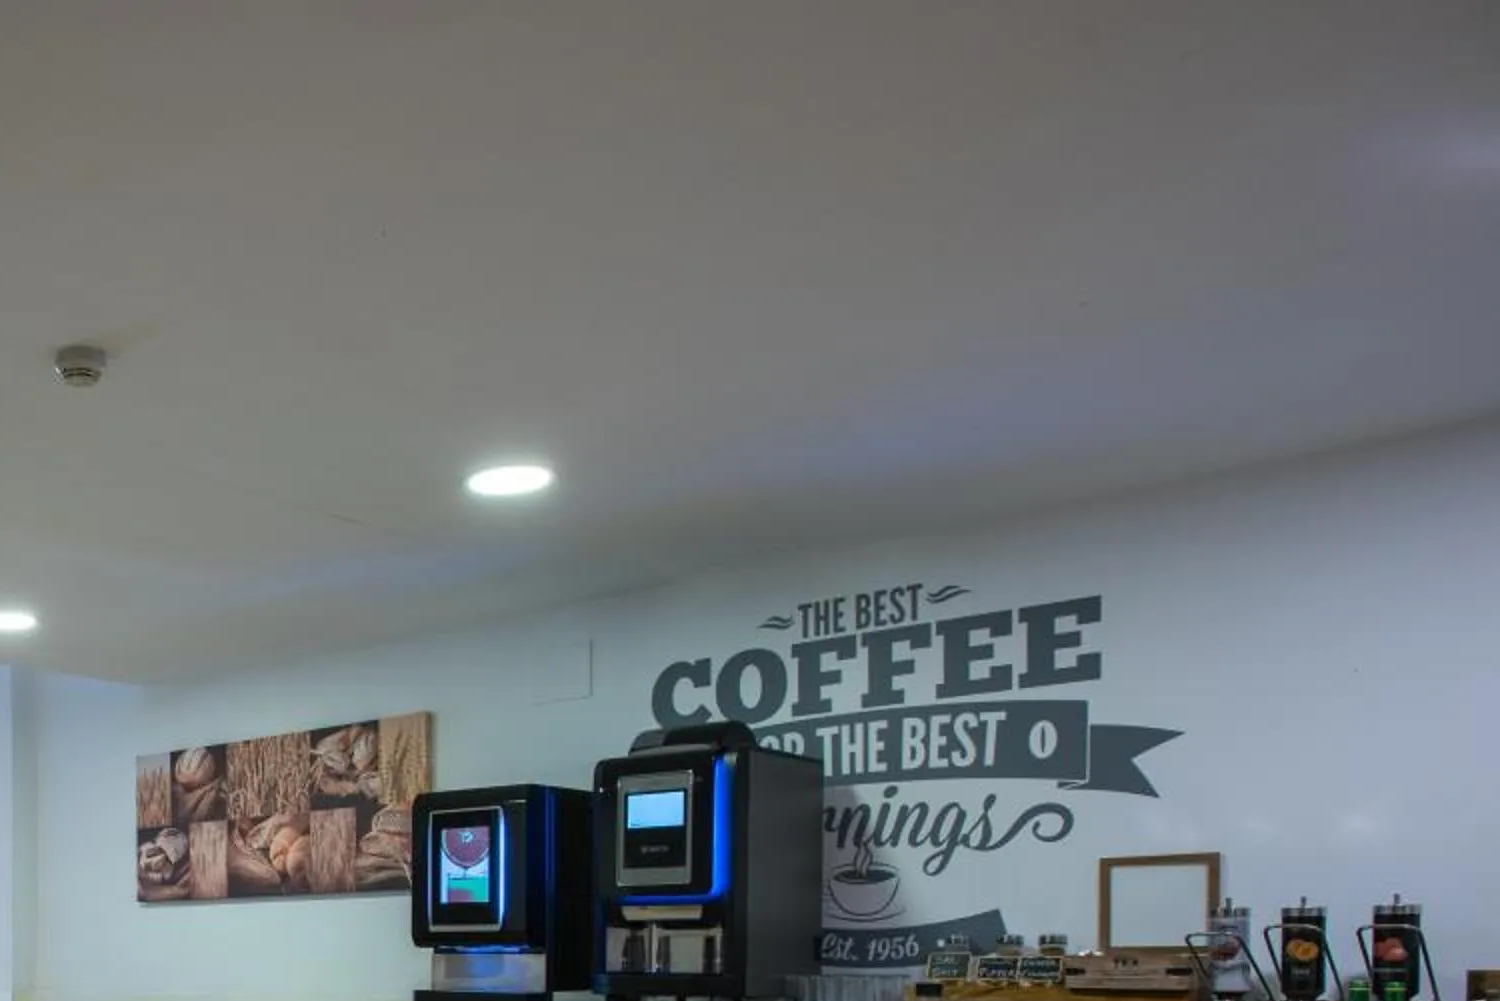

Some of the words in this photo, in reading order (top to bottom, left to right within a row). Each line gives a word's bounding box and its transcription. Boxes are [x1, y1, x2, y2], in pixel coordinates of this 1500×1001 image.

[797, 597, 846, 638] THE
[856, 583, 923, 630] BEST
[651, 595, 1103, 729] COFFEE
[815, 719, 888, 778] THE
[901, 711, 1007, 771] BEST
[821, 932, 859, 961] Est.
[866, 933, 920, 961] 1956
